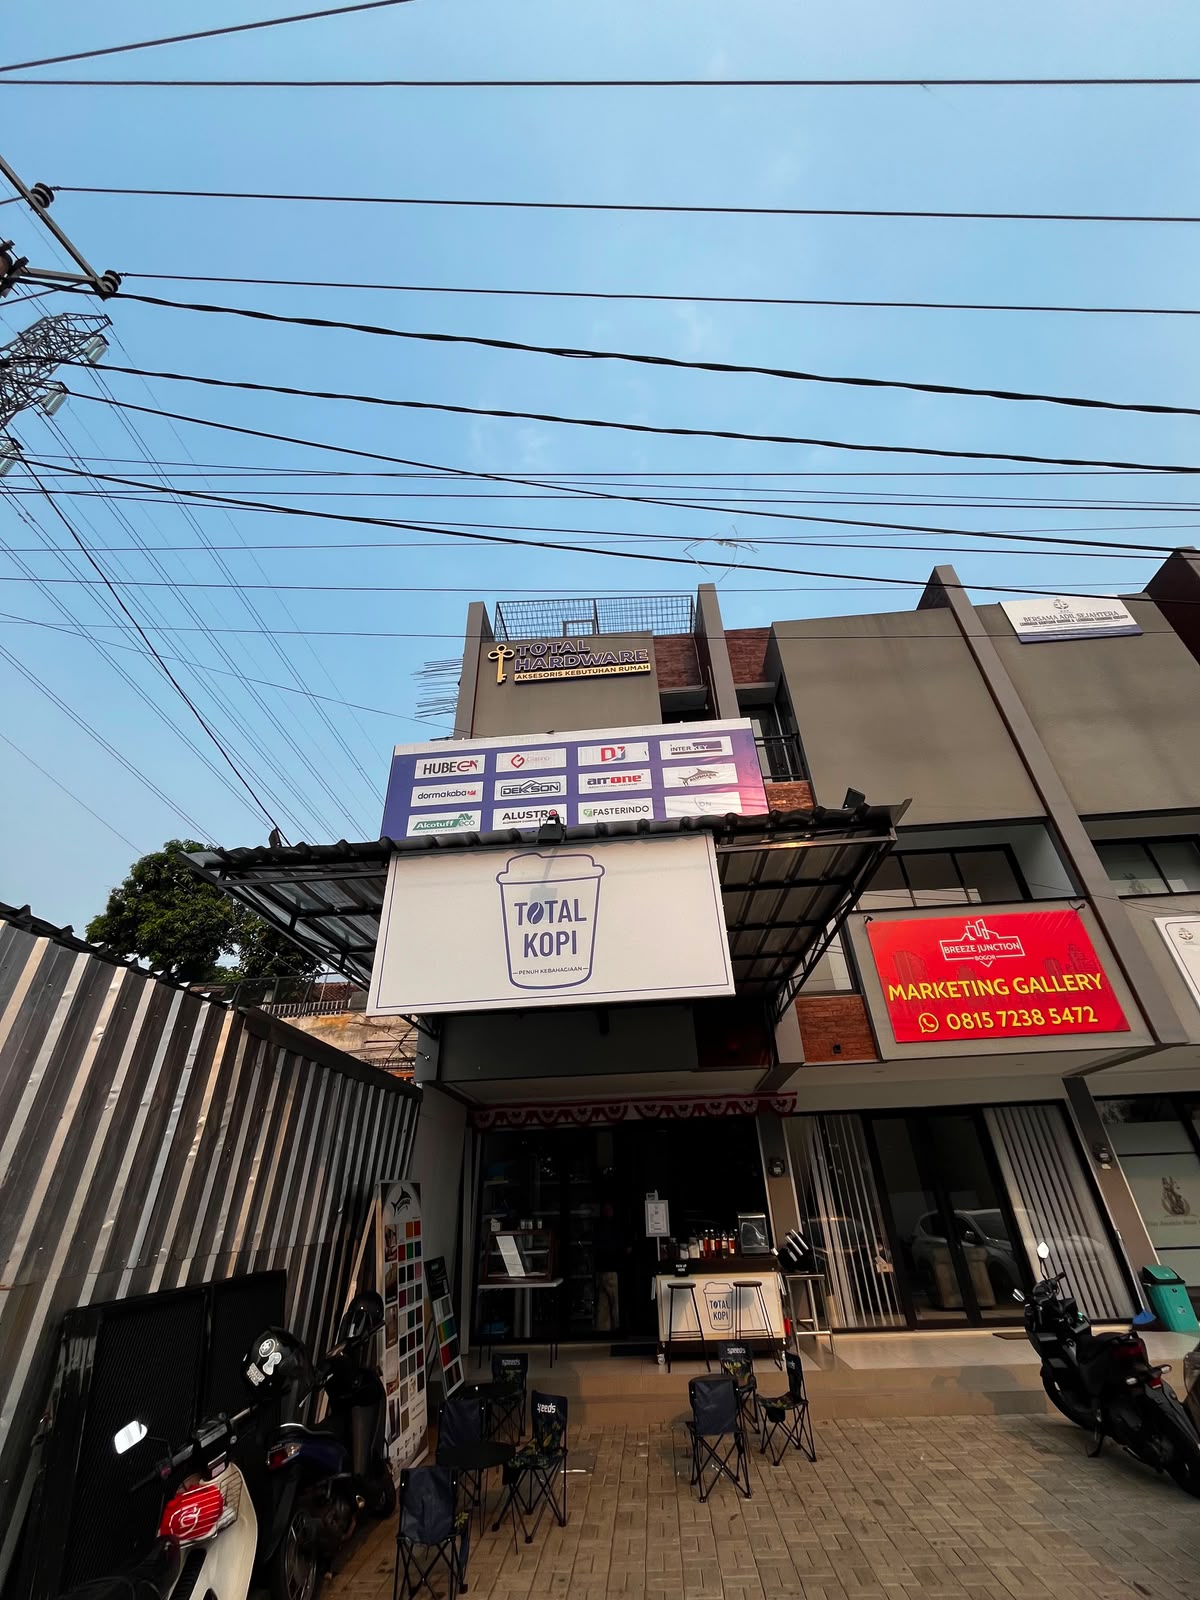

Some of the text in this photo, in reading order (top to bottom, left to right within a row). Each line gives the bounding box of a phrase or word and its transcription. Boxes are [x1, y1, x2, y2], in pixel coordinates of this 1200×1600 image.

[516, 640, 590, 657] TOTAL
[514, 650, 649, 671] HARDWARE
[515, 664, 650, 681] AKSESORIS KEBUTUHAN RUMAH
[417, 789, 467, 800] dormakaba
[503, 781, 559, 795] DEKSON
[592, 805, 650, 816] FASTERINDO
[416, 820, 454, 829] Alcotuff
[514, 899, 587, 925] TOTAL
[523, 929, 577, 958] KOPI
[943, 942, 1021, 954] BREEZE JUNCTION
[540, 966, 583, 974] KEBAHAGIAAN
[887, 972, 1103, 1002] MARKETING GALLERY
[945, 1005, 1099, 1031] 0815 7238 5472
[709, 1299, 731, 1310] TOTAL
[712, 1311, 729, 1321] KOPI
